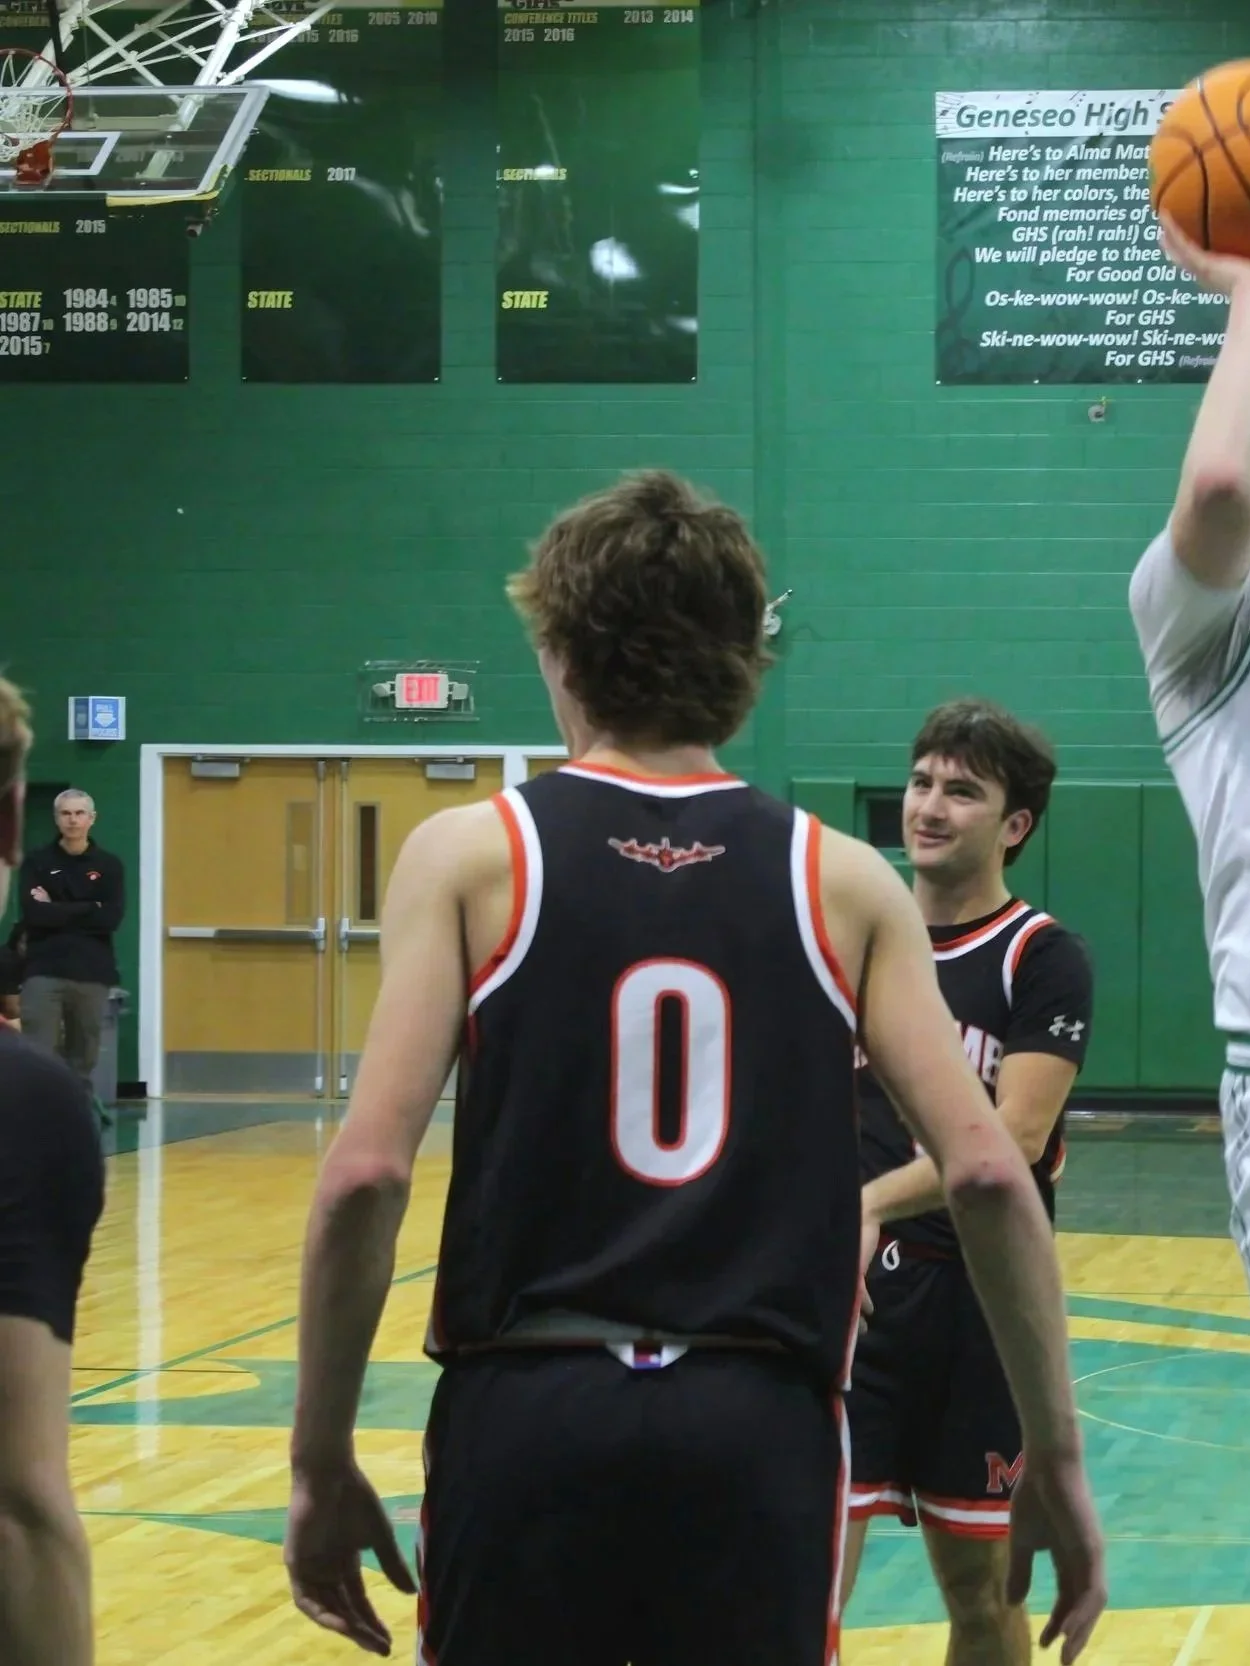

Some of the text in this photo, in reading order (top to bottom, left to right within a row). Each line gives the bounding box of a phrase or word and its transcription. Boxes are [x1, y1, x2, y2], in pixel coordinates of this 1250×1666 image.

[504, 10, 694, 24] CONFERENCE TITLES 2013 2014
[328, 29, 358, 42] 2016
[504, 28, 574, 42] 2015 2016
[956, 104, 1076, 128] Geneseo
[1084, 101, 1149, 131] High
[988, 144, 1151, 161] Here's to Alma Mat
[249, 168, 355, 181] SECTIONALS 2017
[965, 165, 1150, 182] Here's to her member
[954, 187, 1006, 202] Here's
[1011, 187, 1028, 201] to
[1032, 186, 1061, 201] her
[1064, 185, 1118, 203] colors,
[998, 206, 1039, 222] Fond
[1043, 207, 1126, 222] memories
[1130, 205, 1151, 224] of
[0, 220, 105, 233] SECTIONALS 2015
[1012, 224, 1166, 244] GHS (rah! rah!) GH
[974, 246, 1161, 265] We will pledge to thee
[1066, 267, 1095, 282] For
[1098, 266, 1142, 282] Good
[1147, 265, 1176, 281] Old
[0, 291, 42, 308] STATE
[63, 288, 108, 308] 1984
[126, 288, 172, 308] 1985
[248, 291, 293, 308] STATE
[502, 291, 548, 308] STATE
[985, 289, 1138, 307] Os-ke-wow-wow!
[0, 312, 40, 332] 1987
[63, 312, 108, 332] 1988
[126, 312, 171, 332] 2014
[1106, 310, 1176, 326] For GHS
[0, 336, 42, 355] 2015
[980, 330, 1139, 347] Ski-ne-wow-wow!
[1105, 351, 1135, 367] For
[1137, 350, 1176, 366] GHS
[611, 957, 732, 1187] 0
